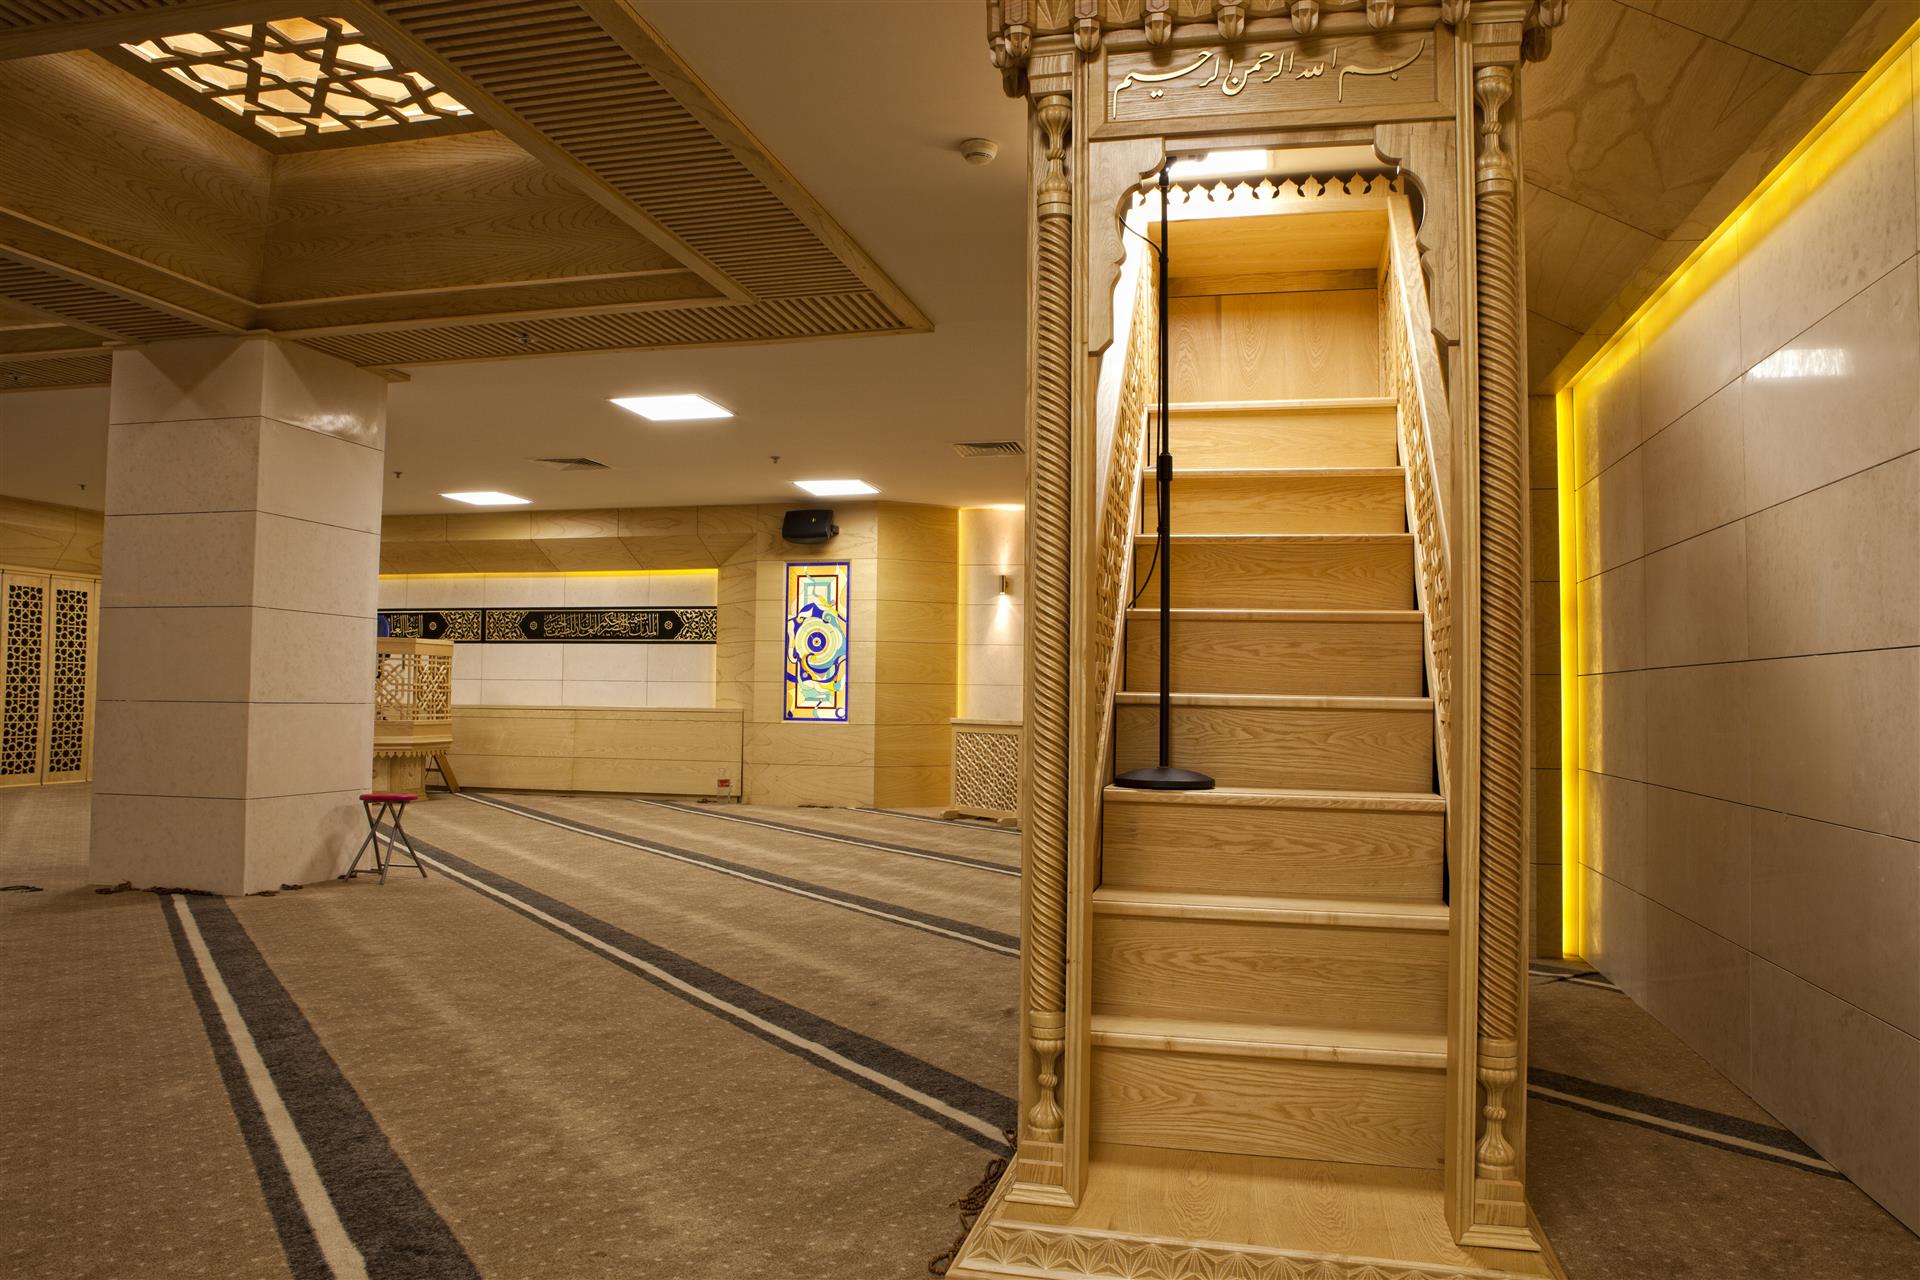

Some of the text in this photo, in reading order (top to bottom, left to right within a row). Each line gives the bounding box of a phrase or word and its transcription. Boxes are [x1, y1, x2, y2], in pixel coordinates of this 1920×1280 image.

[1112, 37, 1426, 119] بسم الله الرحمن الرحيم
